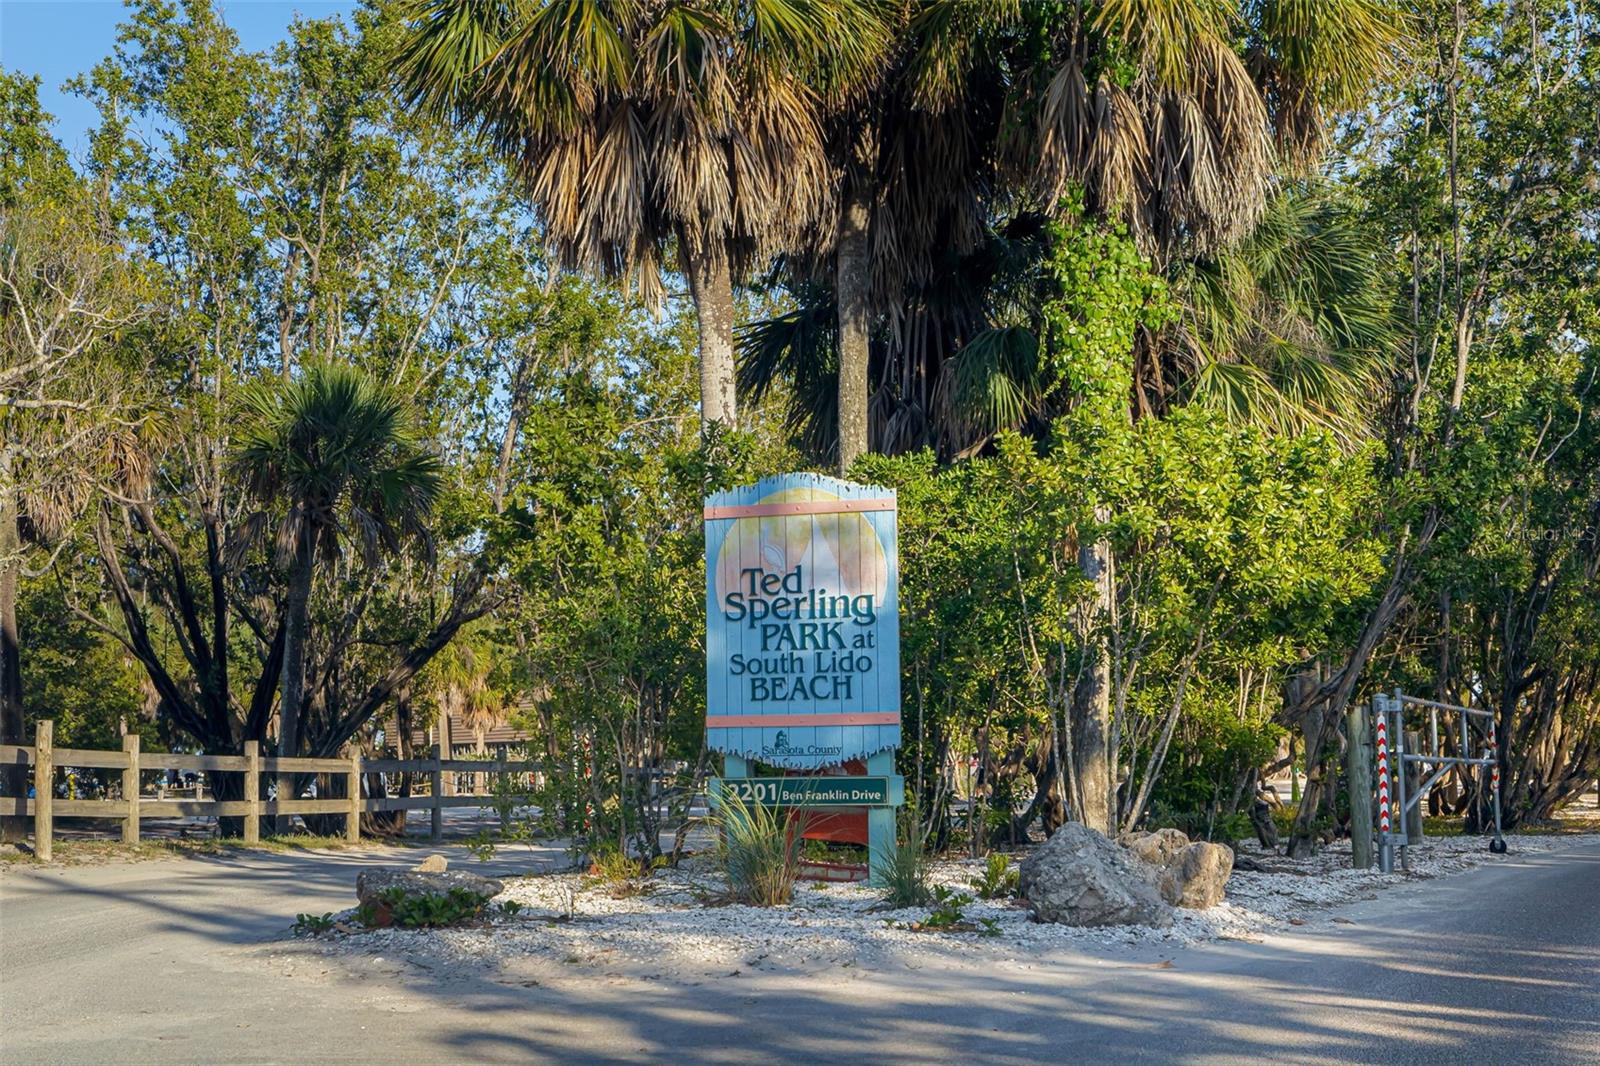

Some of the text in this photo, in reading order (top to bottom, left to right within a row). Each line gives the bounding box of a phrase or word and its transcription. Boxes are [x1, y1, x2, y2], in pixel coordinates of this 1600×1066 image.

[742, 565, 803, 596] Ted
[725, 589, 876, 629] Sperling
[761, 622, 875, 651] PARK at
[730, 651, 873, 675] South Lido
[751, 675, 853, 701] BEACH
[762, 744, 842, 756] Sarasota County
[728, 783, 881, 801] 2201 Ben Franklin Drive
